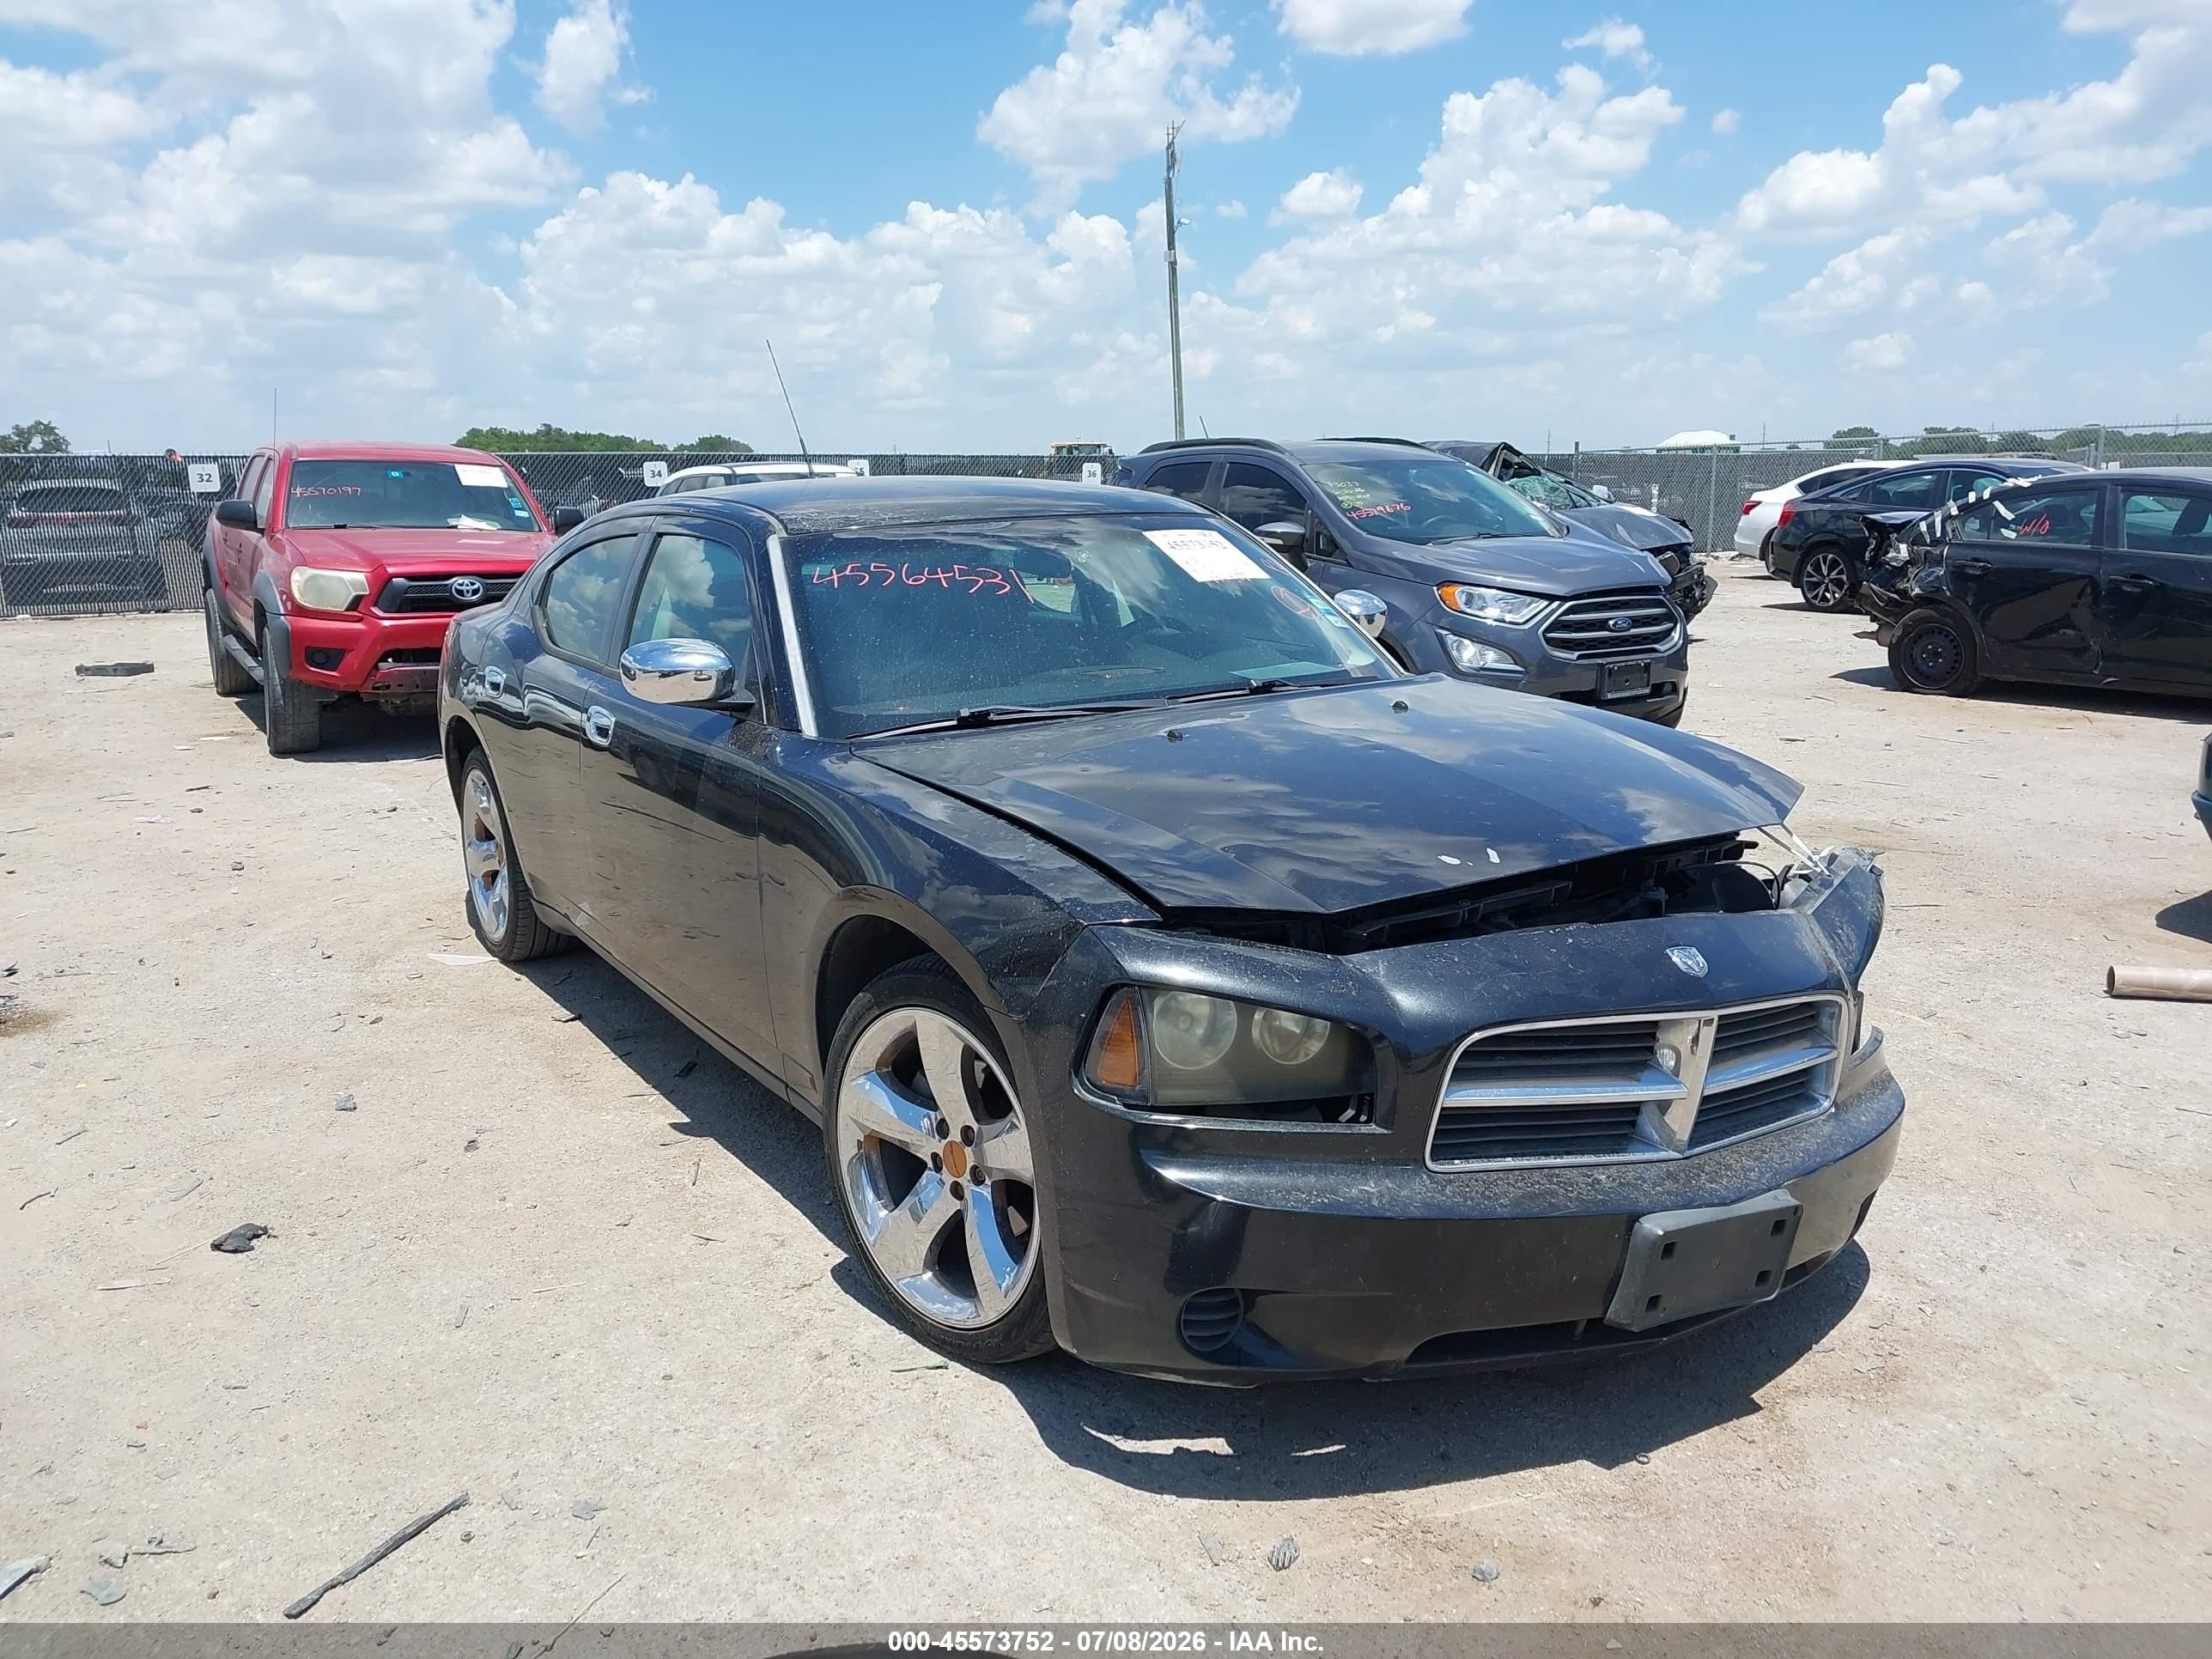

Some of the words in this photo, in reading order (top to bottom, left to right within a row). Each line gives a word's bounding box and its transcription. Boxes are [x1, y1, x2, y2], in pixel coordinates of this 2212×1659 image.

[197, 473, 213, 483] 32
[649, 470, 662, 478] 34
[1086, 470, 1097, 478] 36
[290, 483, 362, 497] 45570197
[812, 562, 1035, 605] 45564531
